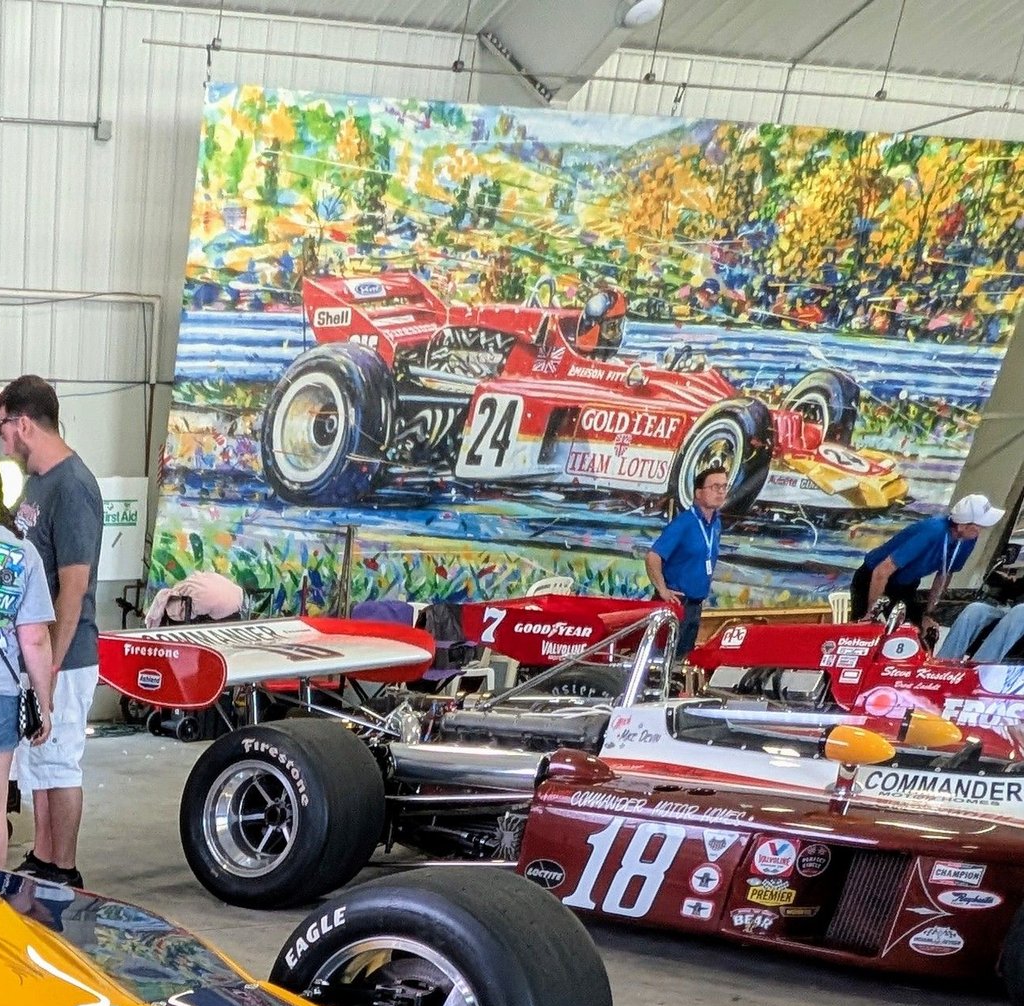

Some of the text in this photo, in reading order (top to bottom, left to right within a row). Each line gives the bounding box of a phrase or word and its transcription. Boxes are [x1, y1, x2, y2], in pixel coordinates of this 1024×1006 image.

[317, 311, 349, 325] Shell
[581, 408, 680, 439] GOLD LEAF
[465, 397, 519, 468] 24
[569, 451, 669, 479] TEAM LOTUS
[121, 510, 138, 521] Aid
[481, 606, 507, 644] 7
[513, 621, 593, 638] GOODYEAR
[123, 643, 180, 659] Firestone
[895, 642, 905, 655] 8
[241, 738, 309, 808] Firestone
[864, 770, 1024, 802] COMMANDER
[570, 790, 648, 813] COMMANDER
[650, 799, 701, 820] MOTOR
[561, 815, 687, 918] 18
[758, 853, 792, 866] VALVOLINE
[526, 866, 564, 882] LOCTITE
[936, 868, 980, 880] CHAMPION
[750, 888, 793, 903] PREMIER
[733, 913, 774, 930] BEAR
[284, 906, 347, 970] EAGLE
